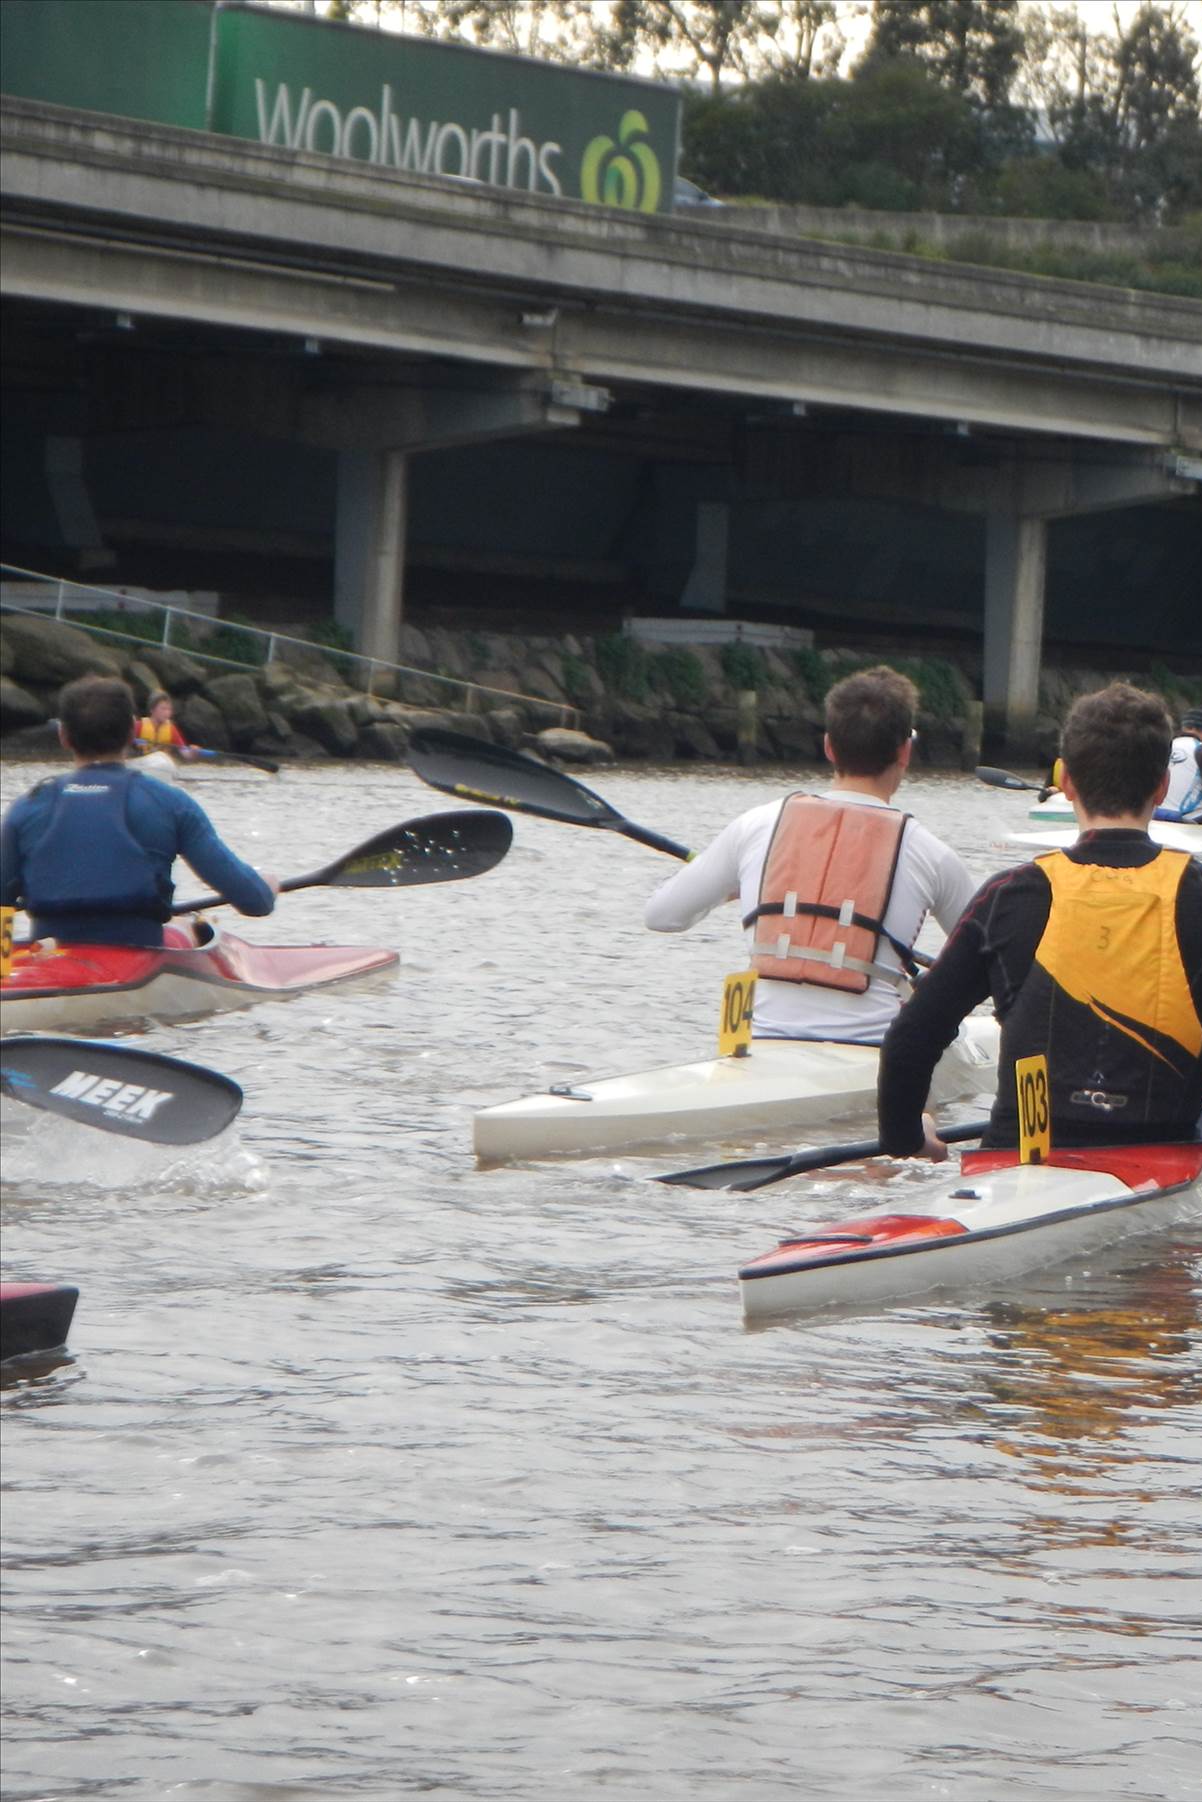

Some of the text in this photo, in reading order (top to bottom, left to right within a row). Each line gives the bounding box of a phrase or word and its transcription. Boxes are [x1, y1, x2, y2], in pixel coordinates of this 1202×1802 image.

[254, 78, 563, 198] Woolworths
[723, 980, 755, 1034] 104
[48, 1070, 176, 1119] MEEK
[1020, 1068, 1049, 1138] 103
